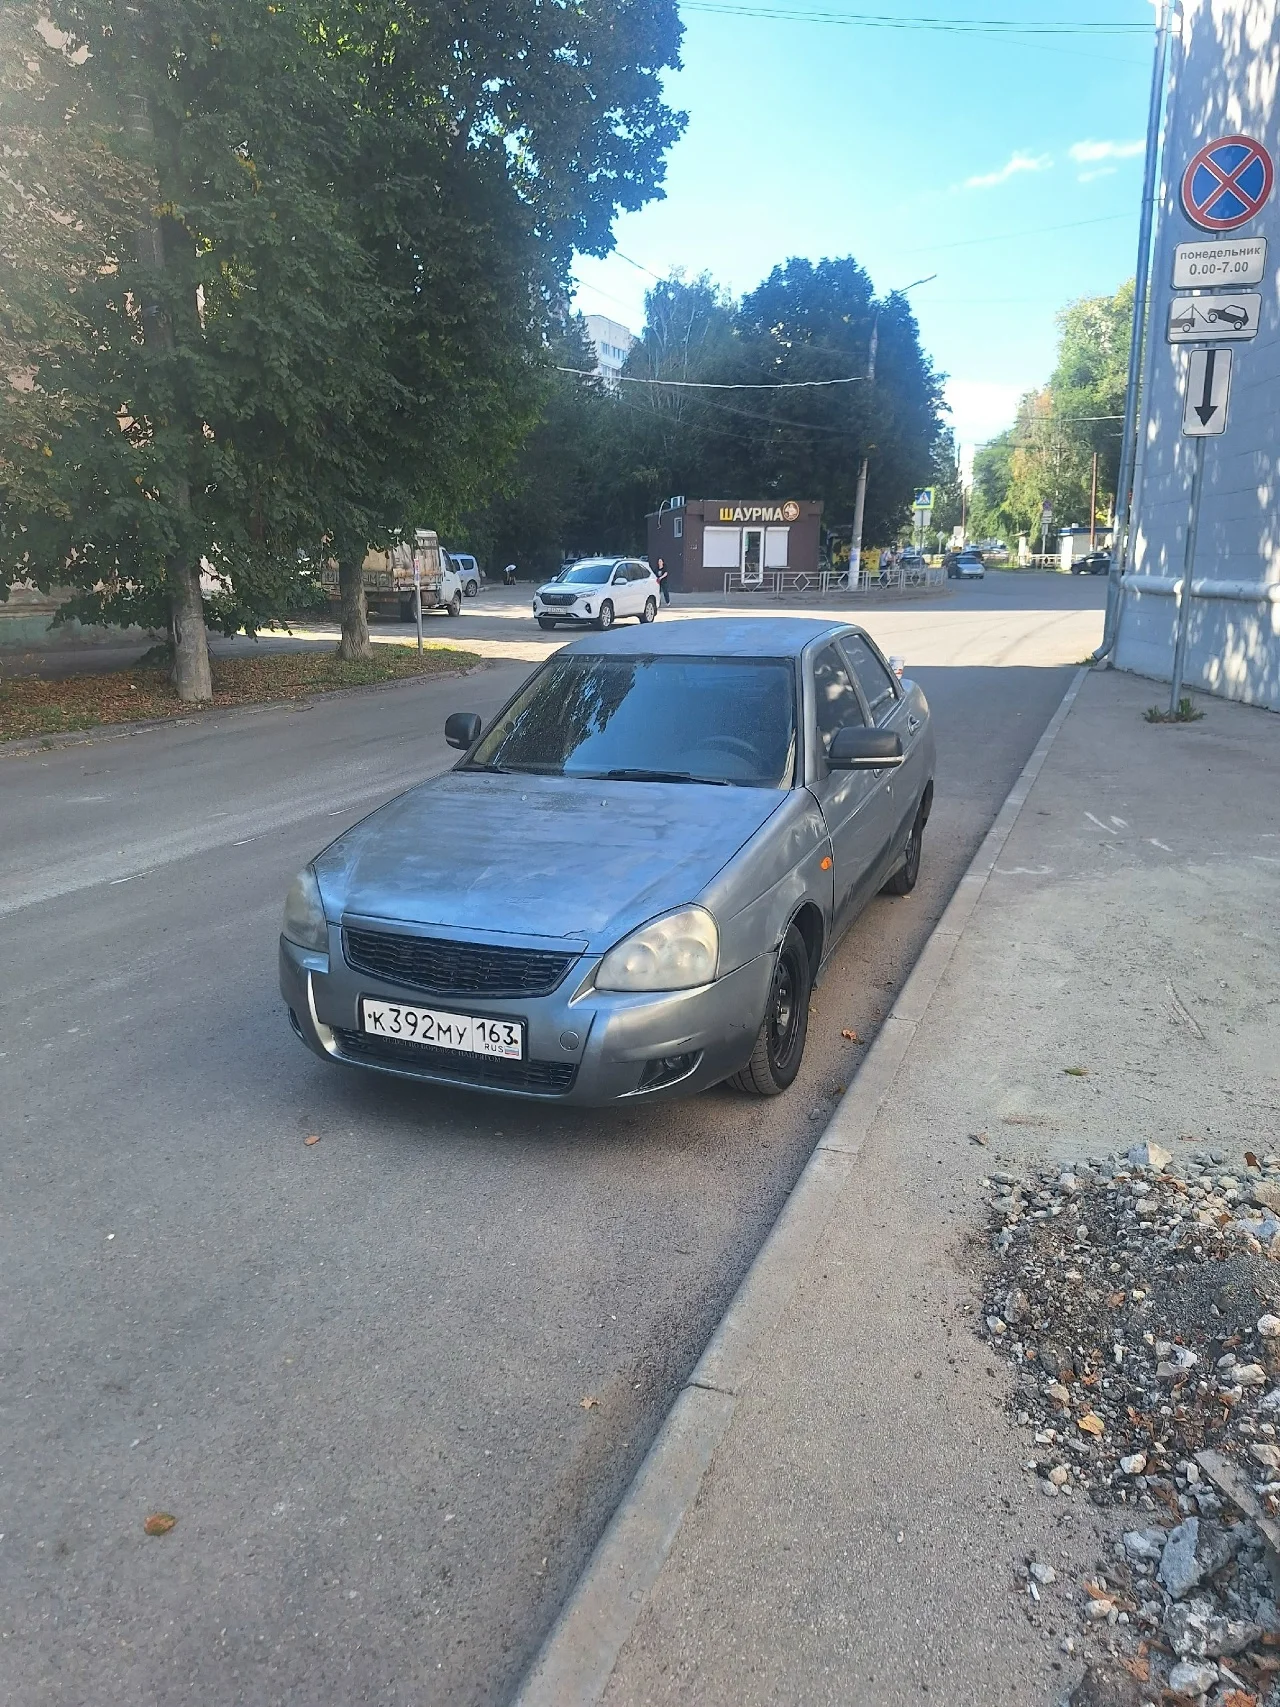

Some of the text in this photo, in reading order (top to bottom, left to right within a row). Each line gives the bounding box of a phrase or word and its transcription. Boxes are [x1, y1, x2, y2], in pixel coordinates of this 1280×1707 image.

[1180, 247, 1261, 260] понедельник
[1189, 261, 1249, 276] 0.00-7.00
[719, 507, 784, 521] ШАУРМА
[476, 1021, 514, 1046] 163
[484, 1042, 504, 1053] RUS
